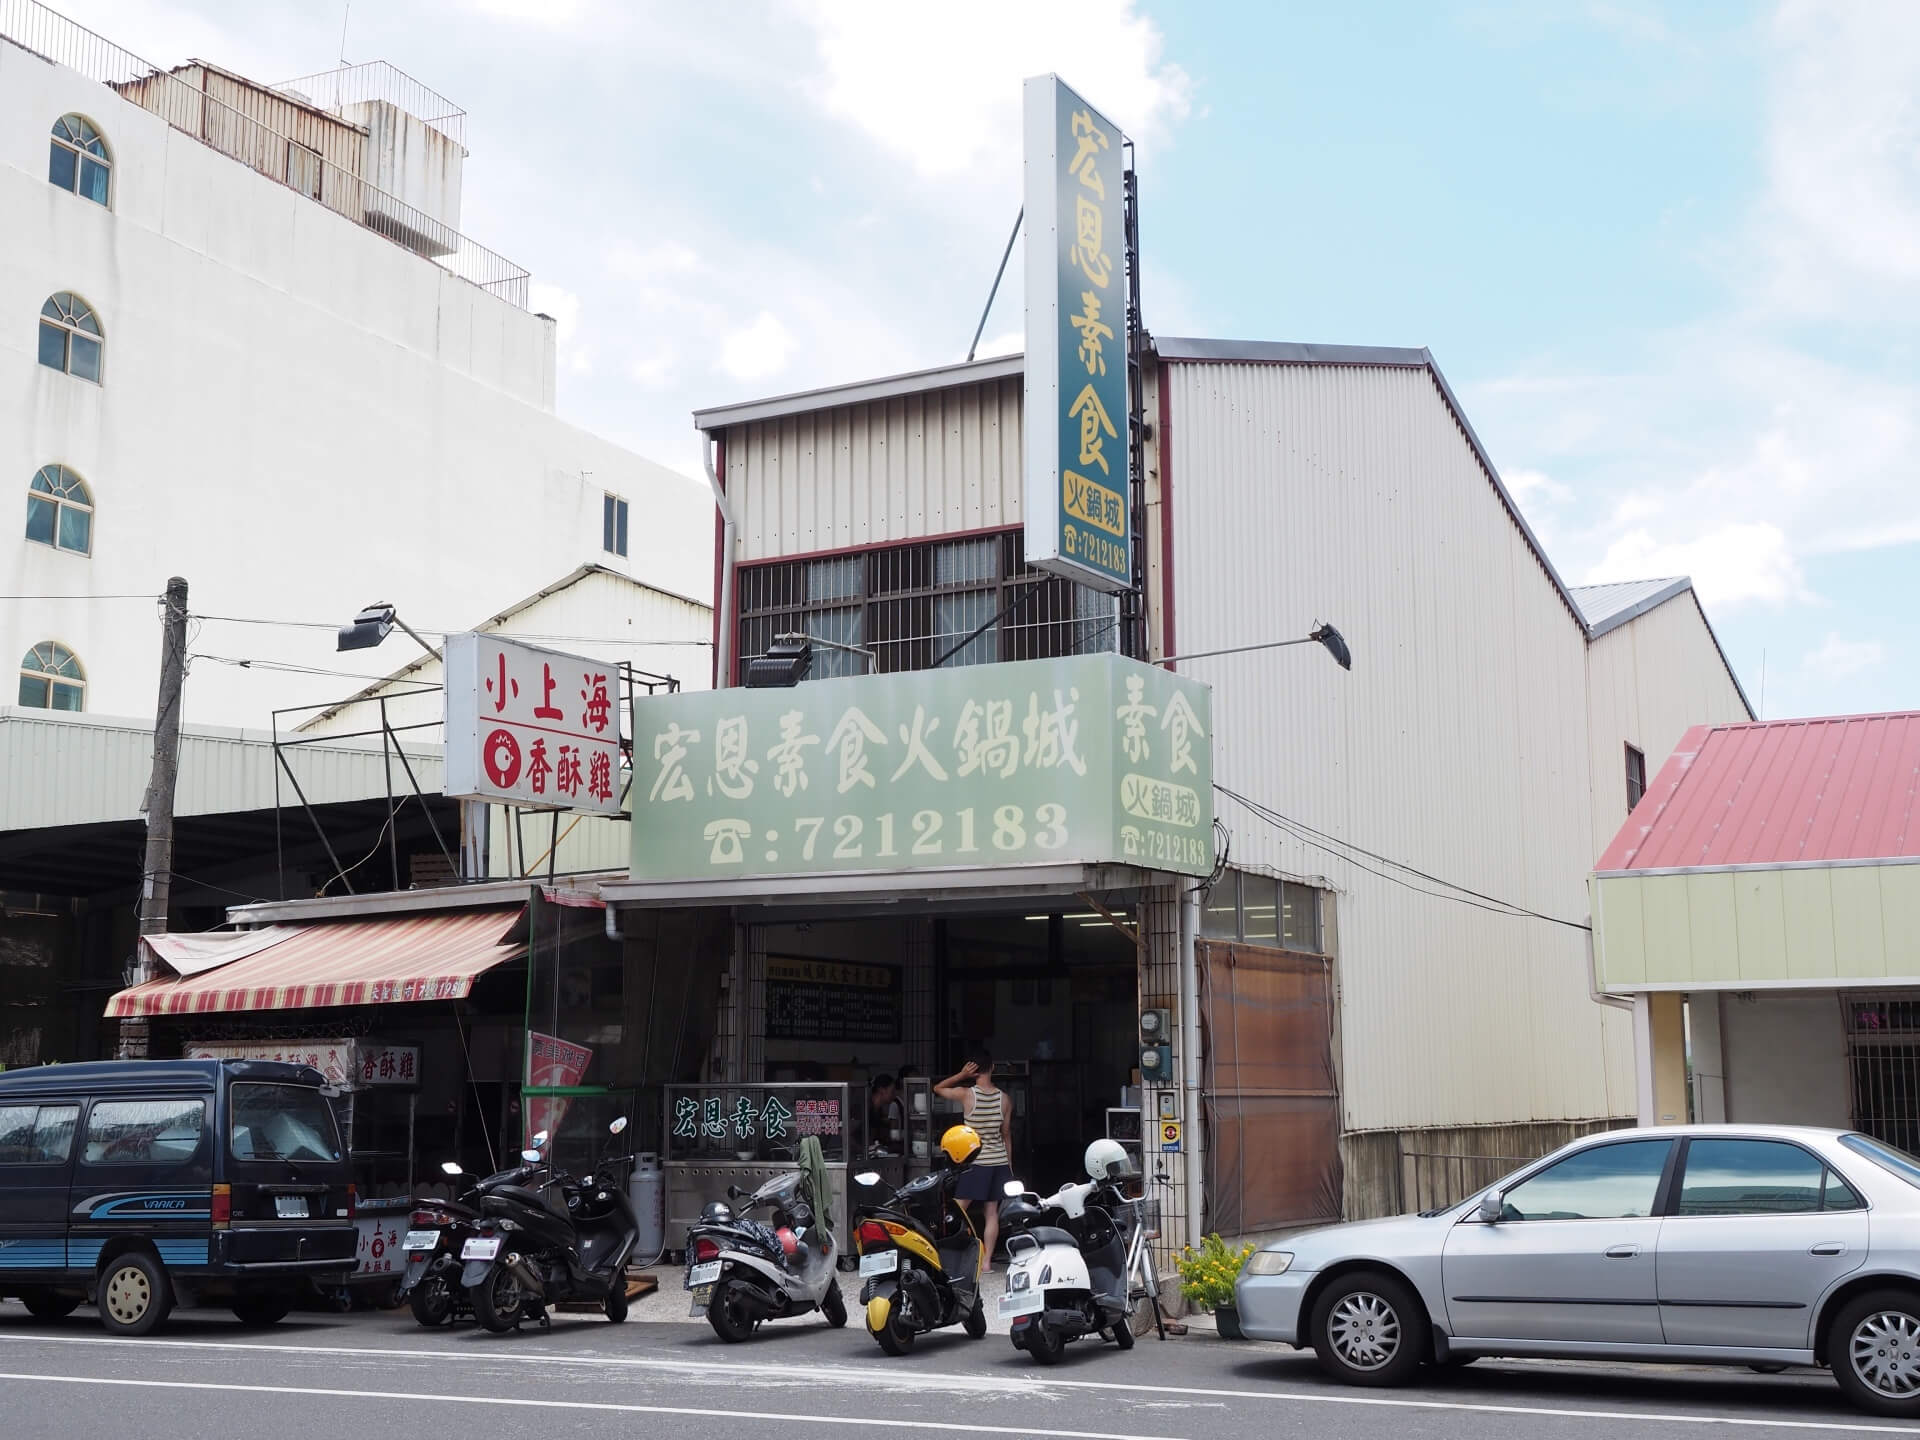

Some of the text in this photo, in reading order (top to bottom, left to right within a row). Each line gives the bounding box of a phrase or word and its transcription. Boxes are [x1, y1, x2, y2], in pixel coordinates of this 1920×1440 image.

[1067, 109, 1119, 475] 宏恩素食
[1068, 477, 1121, 531] 火鍋城
[486, 652, 612, 734] 小上海
[649, 687, 1087, 803] 宏恩素食火鍋城
[1116, 673, 1205, 776] 素食
[525, 737, 613, 805] 香酥雞
[1127, 777, 1197, 826] 火鍋城
[362, 1050, 415, 1080] 香酥雞
[673, 1096, 792, 1139] 宏恩素食
[143, 1200, 186, 1209] VARICA
